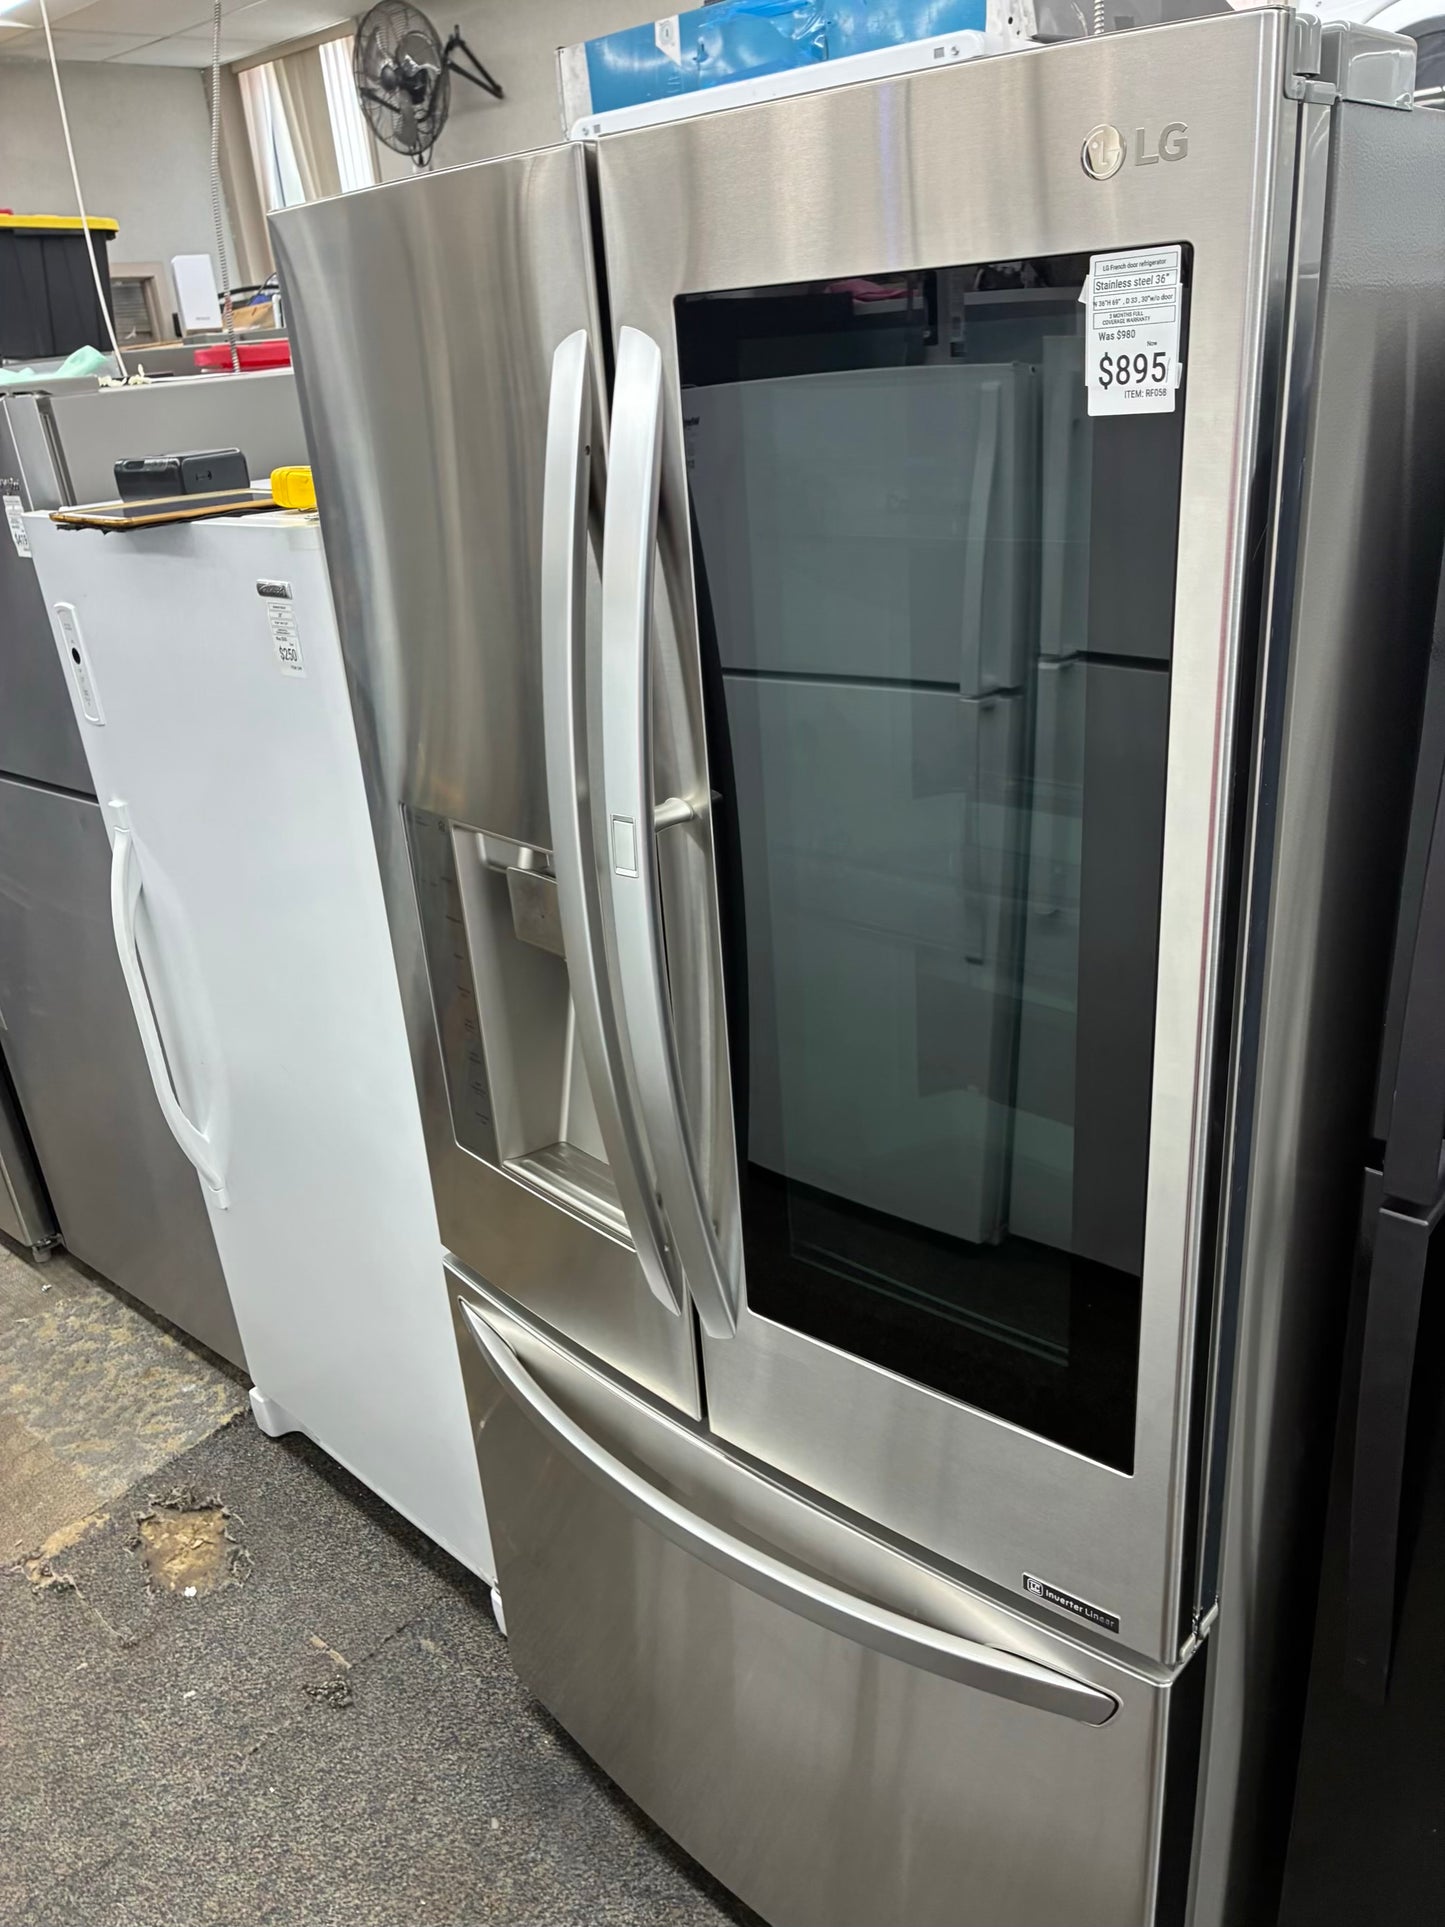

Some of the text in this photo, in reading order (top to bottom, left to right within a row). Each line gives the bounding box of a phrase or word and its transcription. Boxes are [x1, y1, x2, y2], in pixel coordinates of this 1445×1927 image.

[1135, 121, 1189, 167] LG
[1139, 259, 1166, 267] refrigerator
[1096, 273, 1169, 291] Stainless steel 36"
[1098, 330, 1135, 341] Was $980
[1099, 352, 1166, 390] $895
[1125, 388, 1167, 398] ITEM: RF058
[279, 645, 298, 662] $250
[1046, 1590, 1083, 1612] Inverter
[1085, 1608, 1114, 1627] Linear
